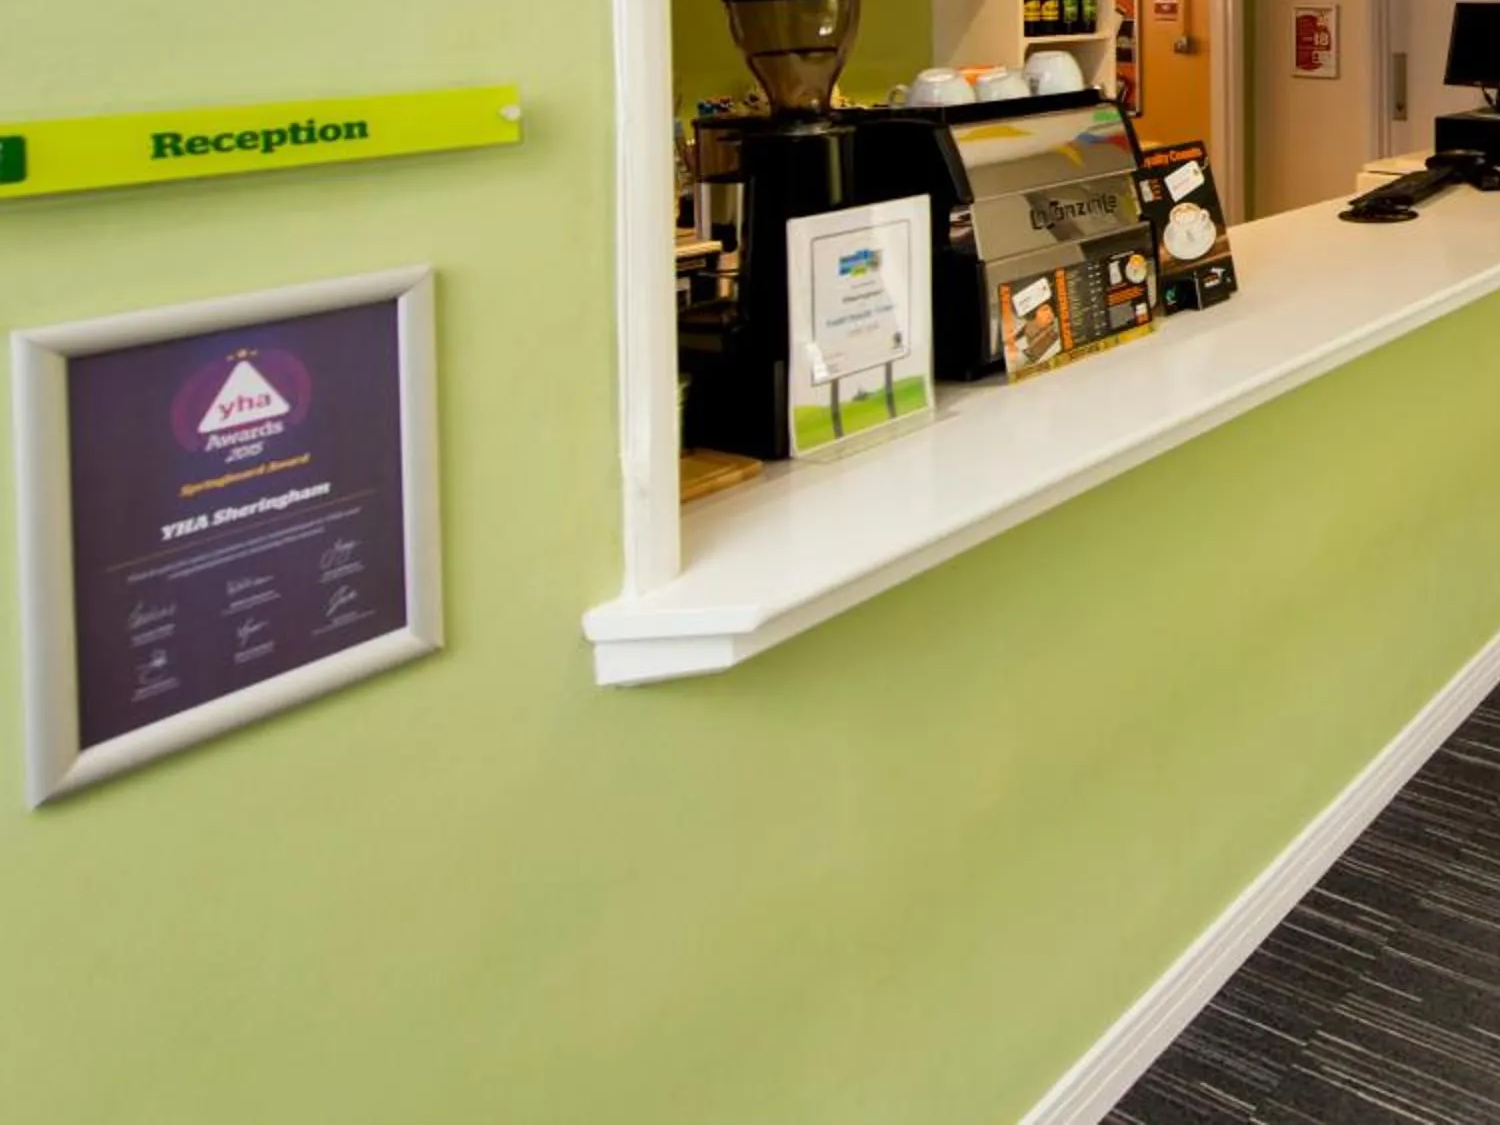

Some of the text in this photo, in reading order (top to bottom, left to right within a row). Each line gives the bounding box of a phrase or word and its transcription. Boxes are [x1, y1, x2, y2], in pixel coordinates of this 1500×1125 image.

[150, 119, 370, 161] Reception
[218, 393, 272, 421] yha
[204, 421, 284, 452] Awards
[160, 481, 331, 541] YHA Sheringham
